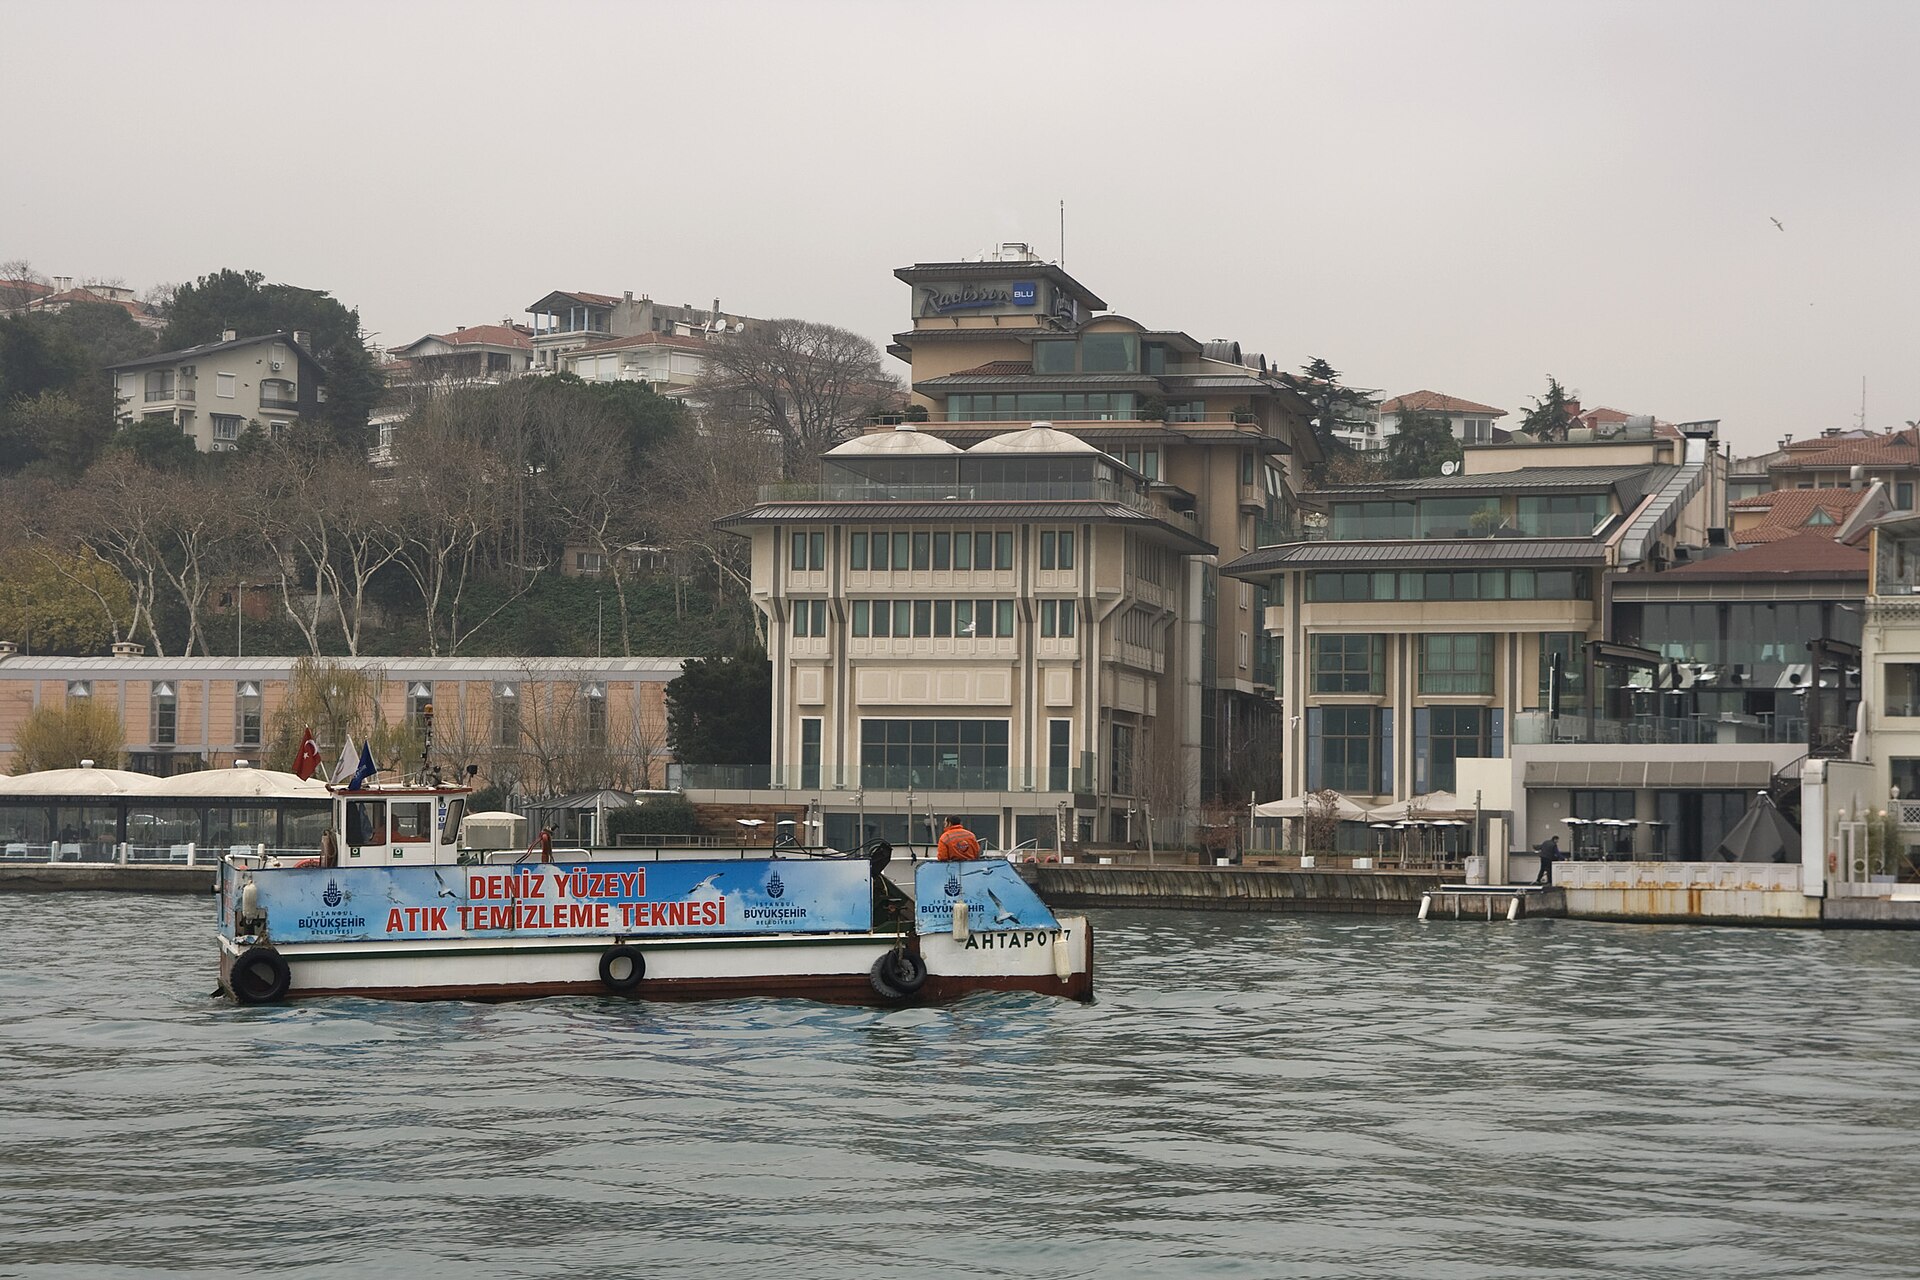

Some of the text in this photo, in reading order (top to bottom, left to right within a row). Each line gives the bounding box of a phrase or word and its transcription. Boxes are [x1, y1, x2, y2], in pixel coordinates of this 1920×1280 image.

[919, 283, 1034, 317] Radisson BLU
[469, 867, 646, 900] DENİZ YÜZEYİ
[386, 896, 726, 932] ATIK TEMİZLEME TEKNESİ
[744, 906, 807, 920] BÜYÜKŞEHİR
[921, 903, 985, 913] BÜYÜKHİR
[298, 915, 366, 930] BÜYÜKŞEHİR
[965, 929, 1071, 950] AHTAPOT 7
